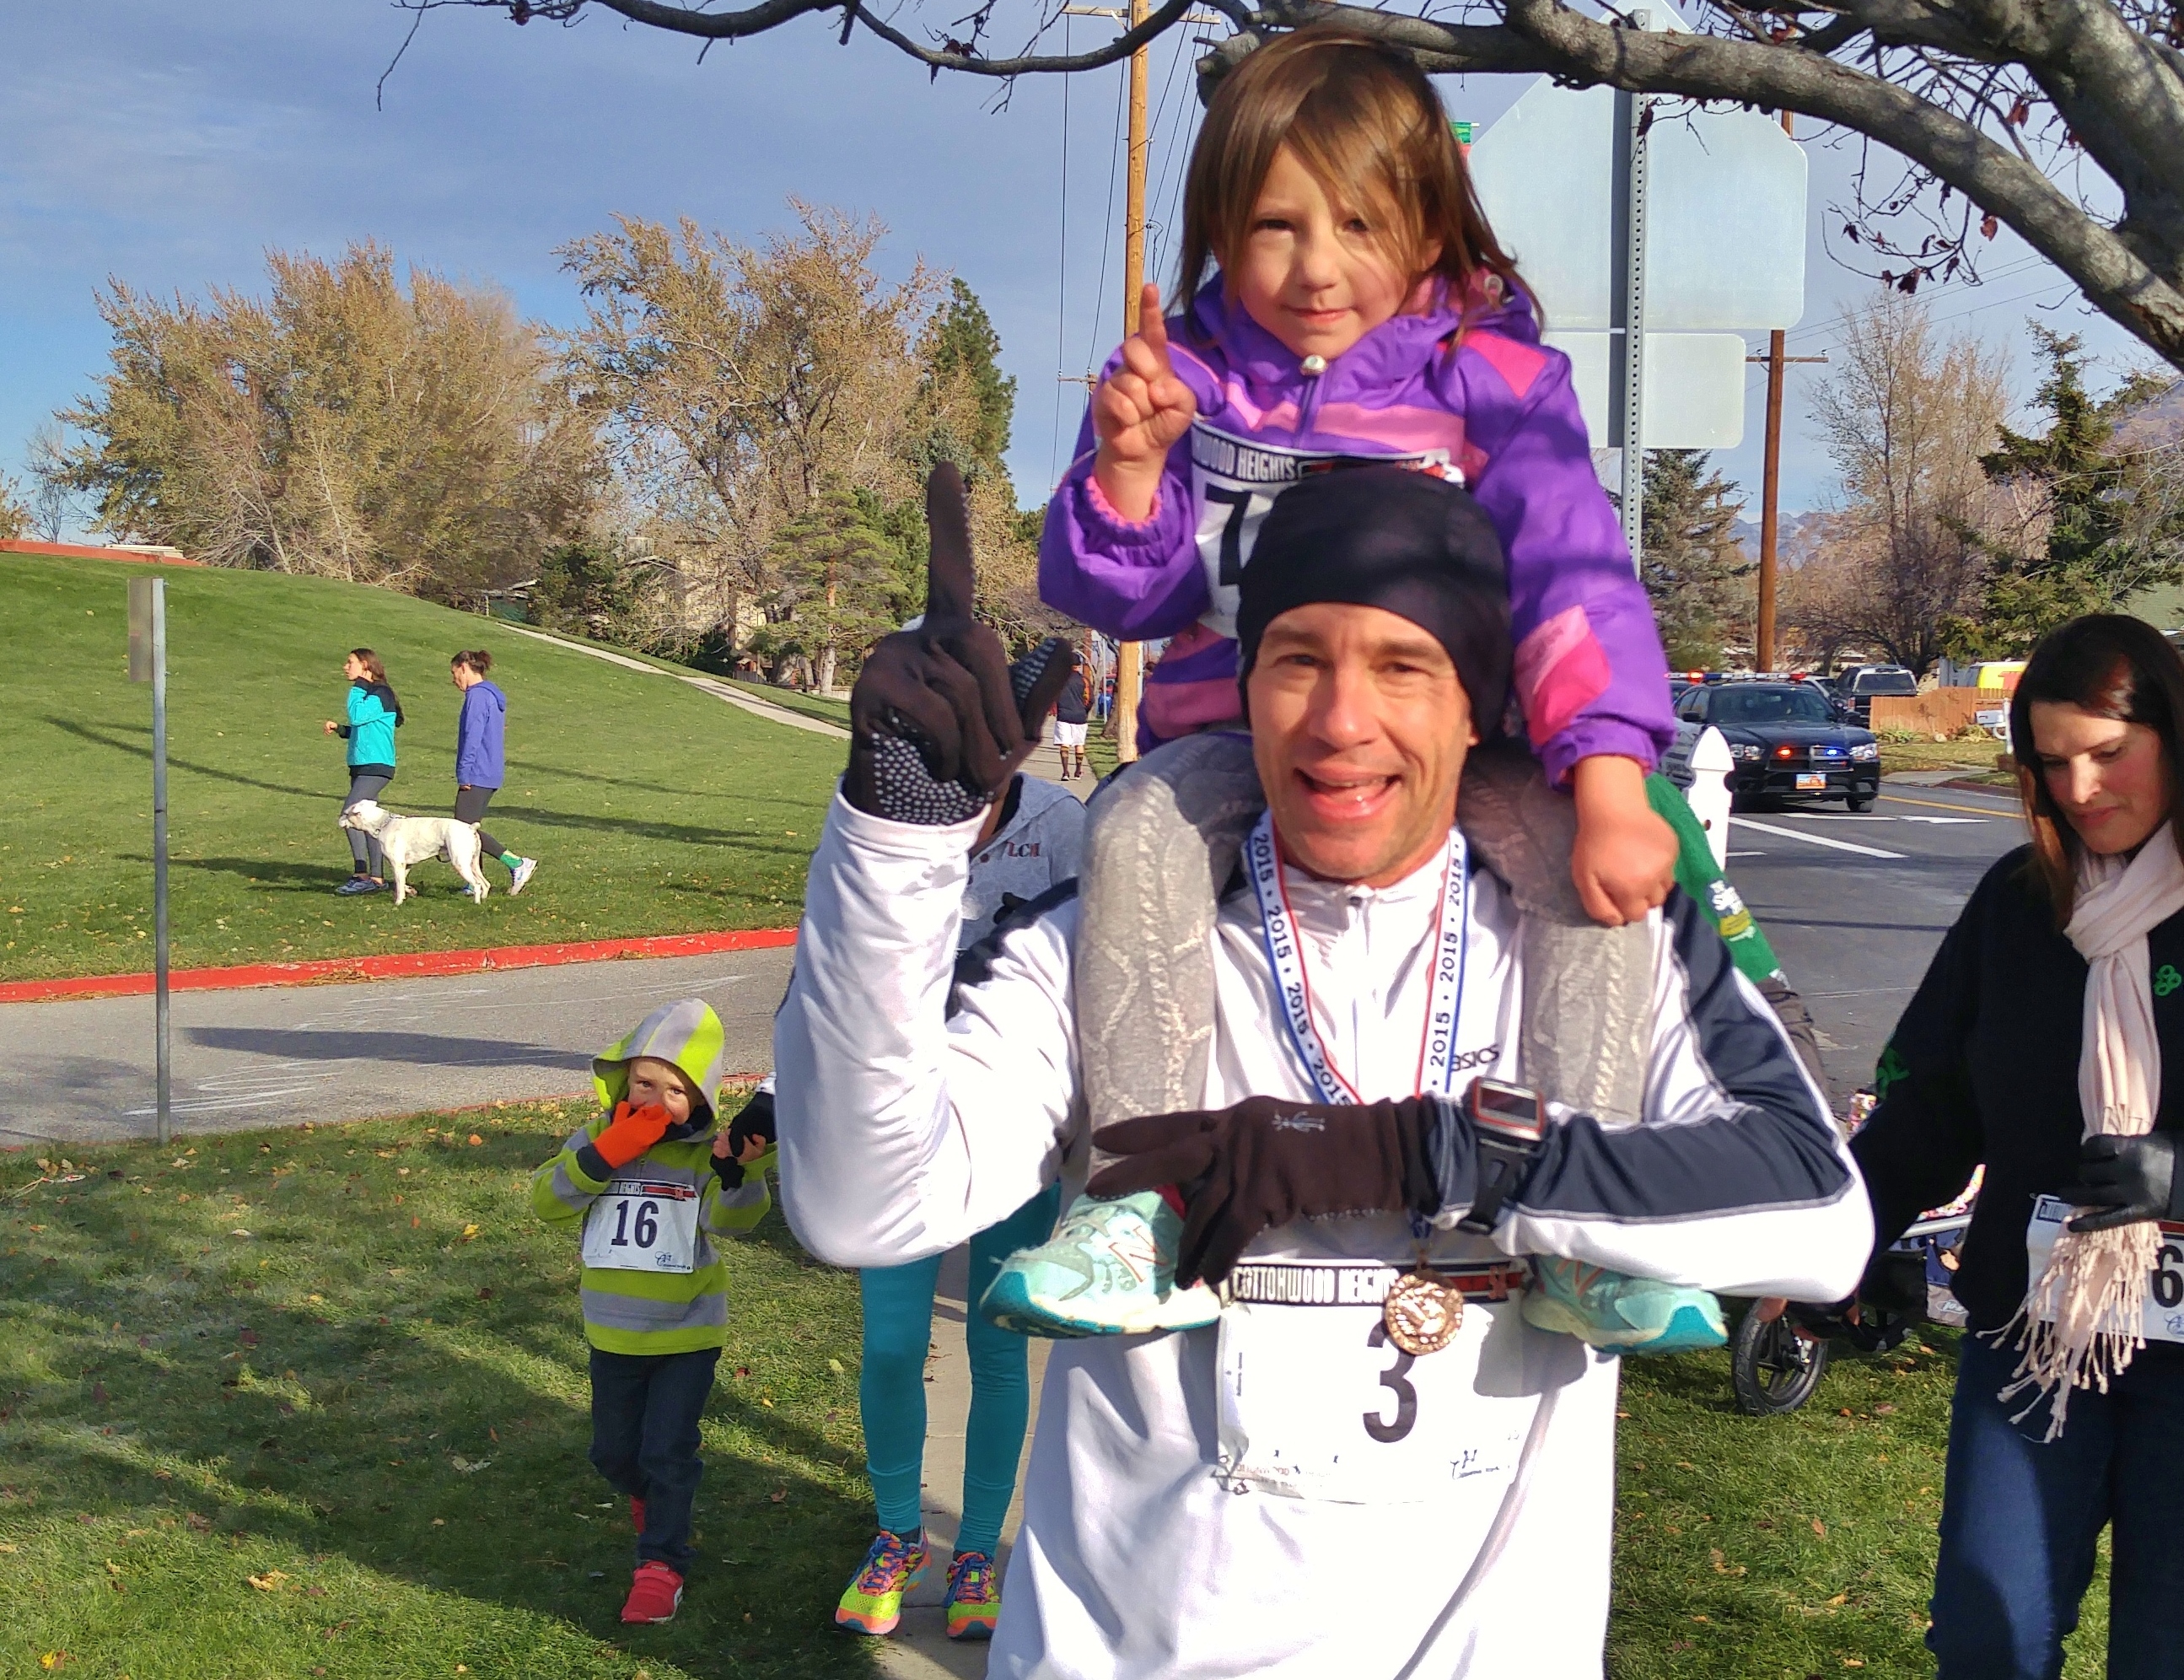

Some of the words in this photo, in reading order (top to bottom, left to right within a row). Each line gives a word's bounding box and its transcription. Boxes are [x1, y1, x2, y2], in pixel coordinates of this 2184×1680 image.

[1236, 447, 1296, 481] HEIGHTS
[1205, 482, 1253, 586] 7
[1254, 833, 1274, 882] 2015
[1267, 905, 1293, 959] 2015
[1439, 931, 1458, 983] 2015
[1286, 982, 1310, 1035] 2015
[1430, 1012, 1450, 1067] 2015
[611, 1200, 659, 1248] 16
[1233, 1266, 1336, 1304] COTTONWOOD
[1363, 1320, 1417, 1443] 3
